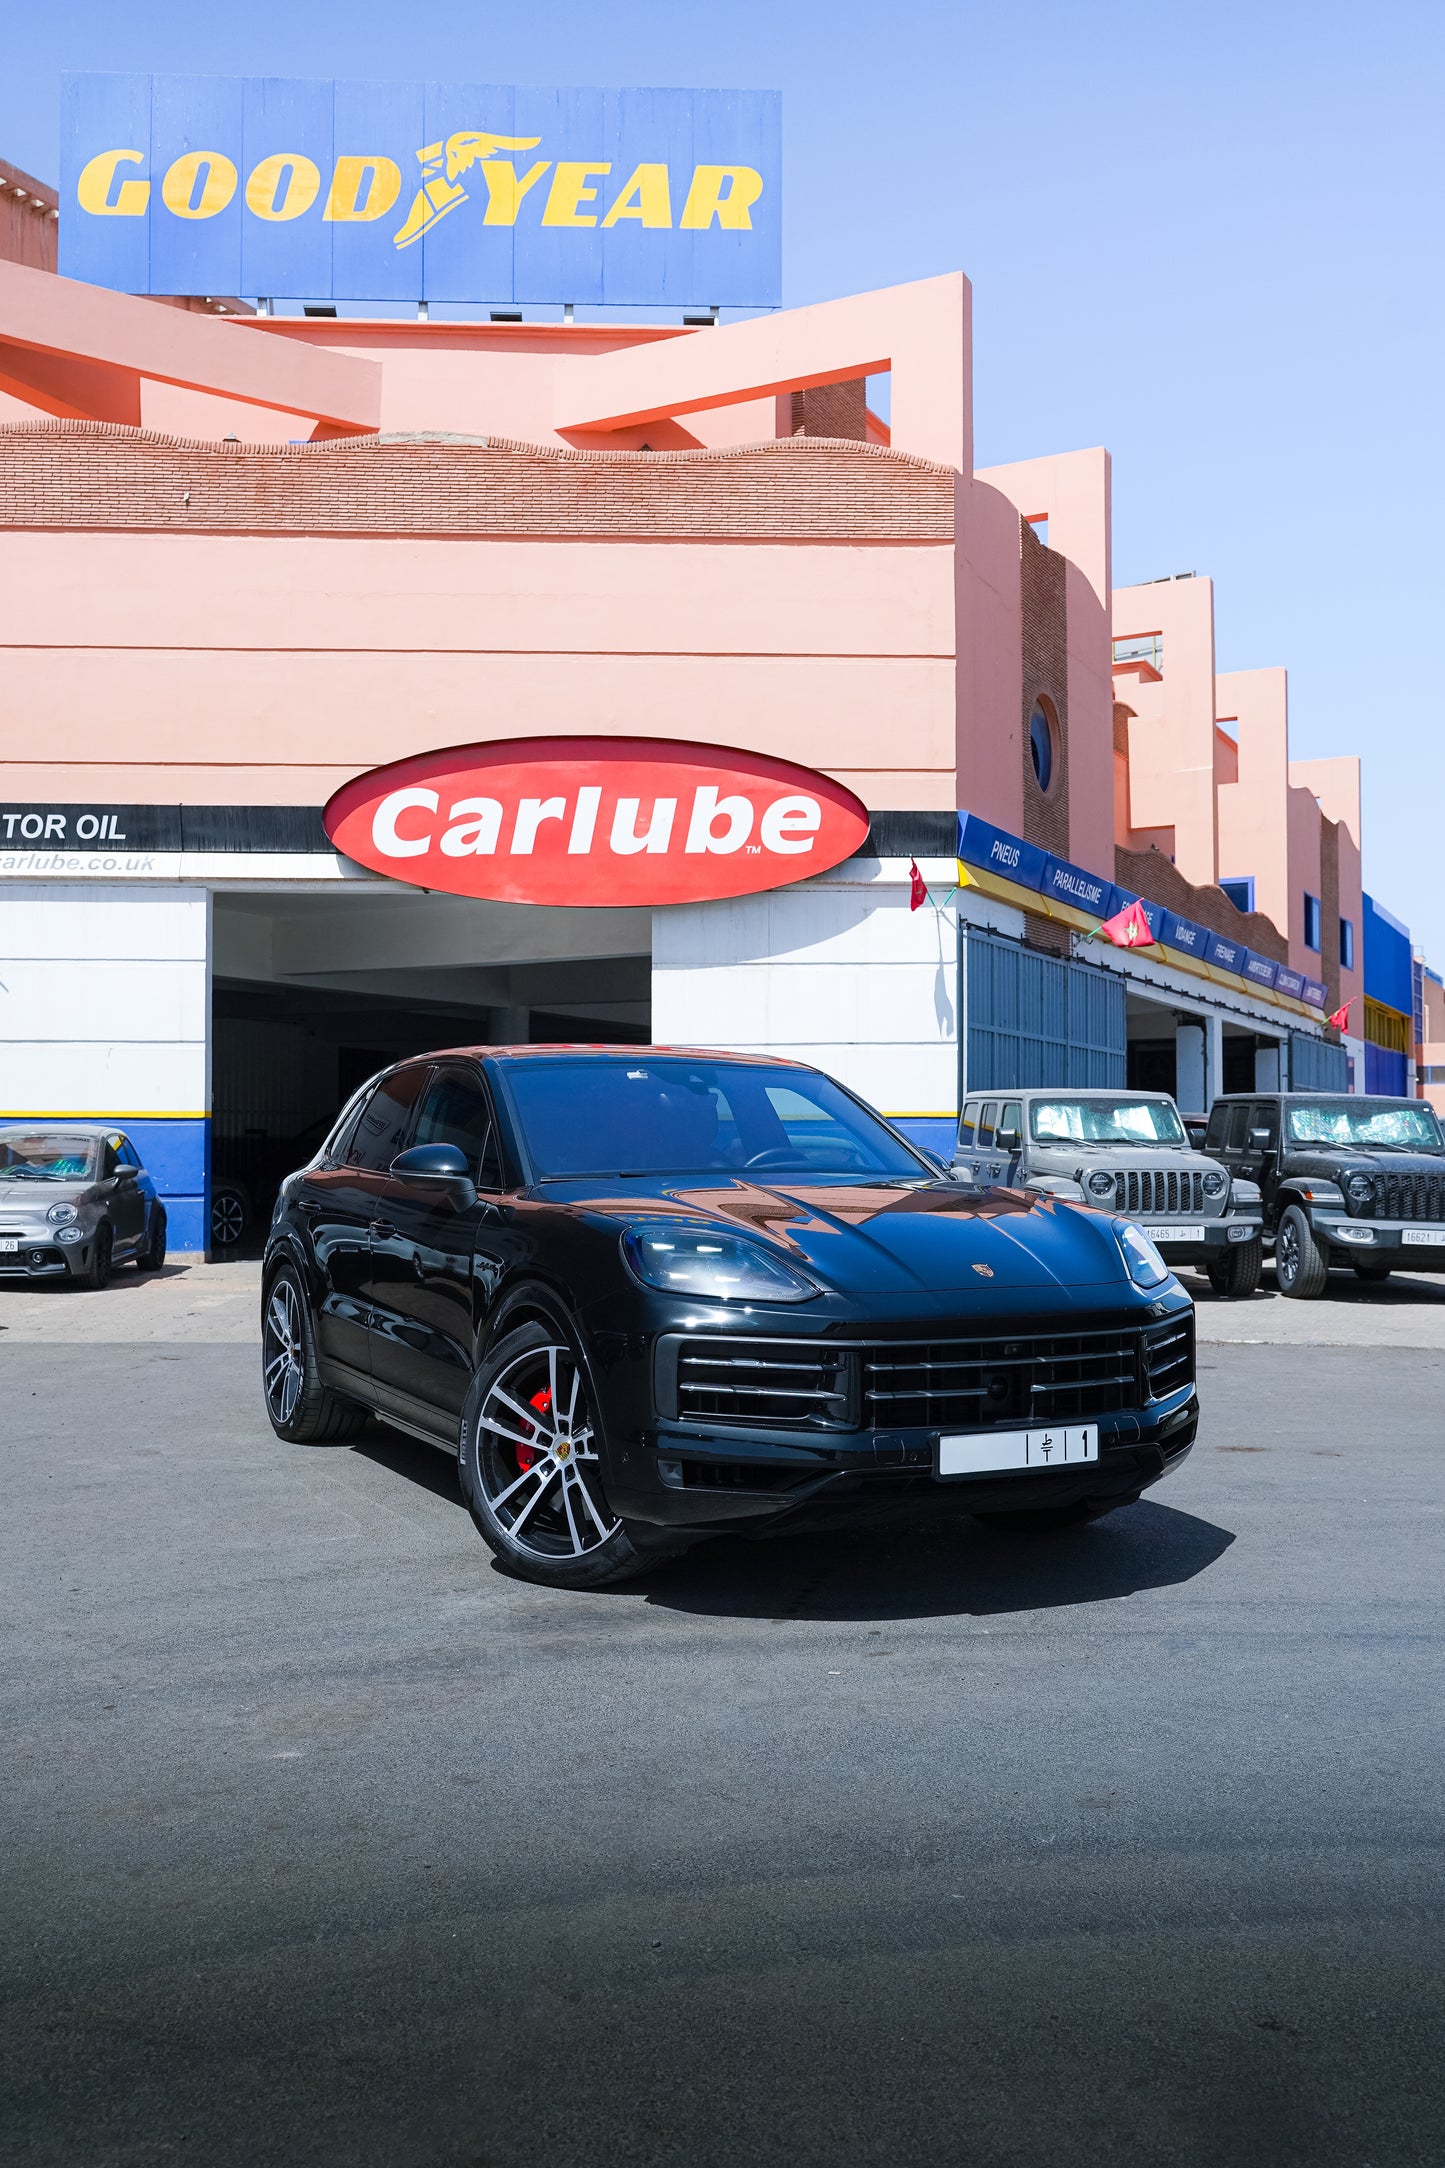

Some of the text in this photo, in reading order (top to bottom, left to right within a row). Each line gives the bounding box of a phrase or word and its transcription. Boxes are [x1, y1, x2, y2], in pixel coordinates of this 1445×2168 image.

[76, 814, 127, 840] OIL
[371, 785, 822, 859] Carlube
[0, 853, 156, 871] arlube.co.uk
[990, 840, 1020, 868] PNEUS
[1052, 869, 1102, 905] PARALLELISME
[1175, 925, 1196, 946] VIDANGE
[5, 1240, 15, 1250] 26
[1407, 1232, 1430, 1243] 16621
[1082, 1430, 1087, 1457] 1
